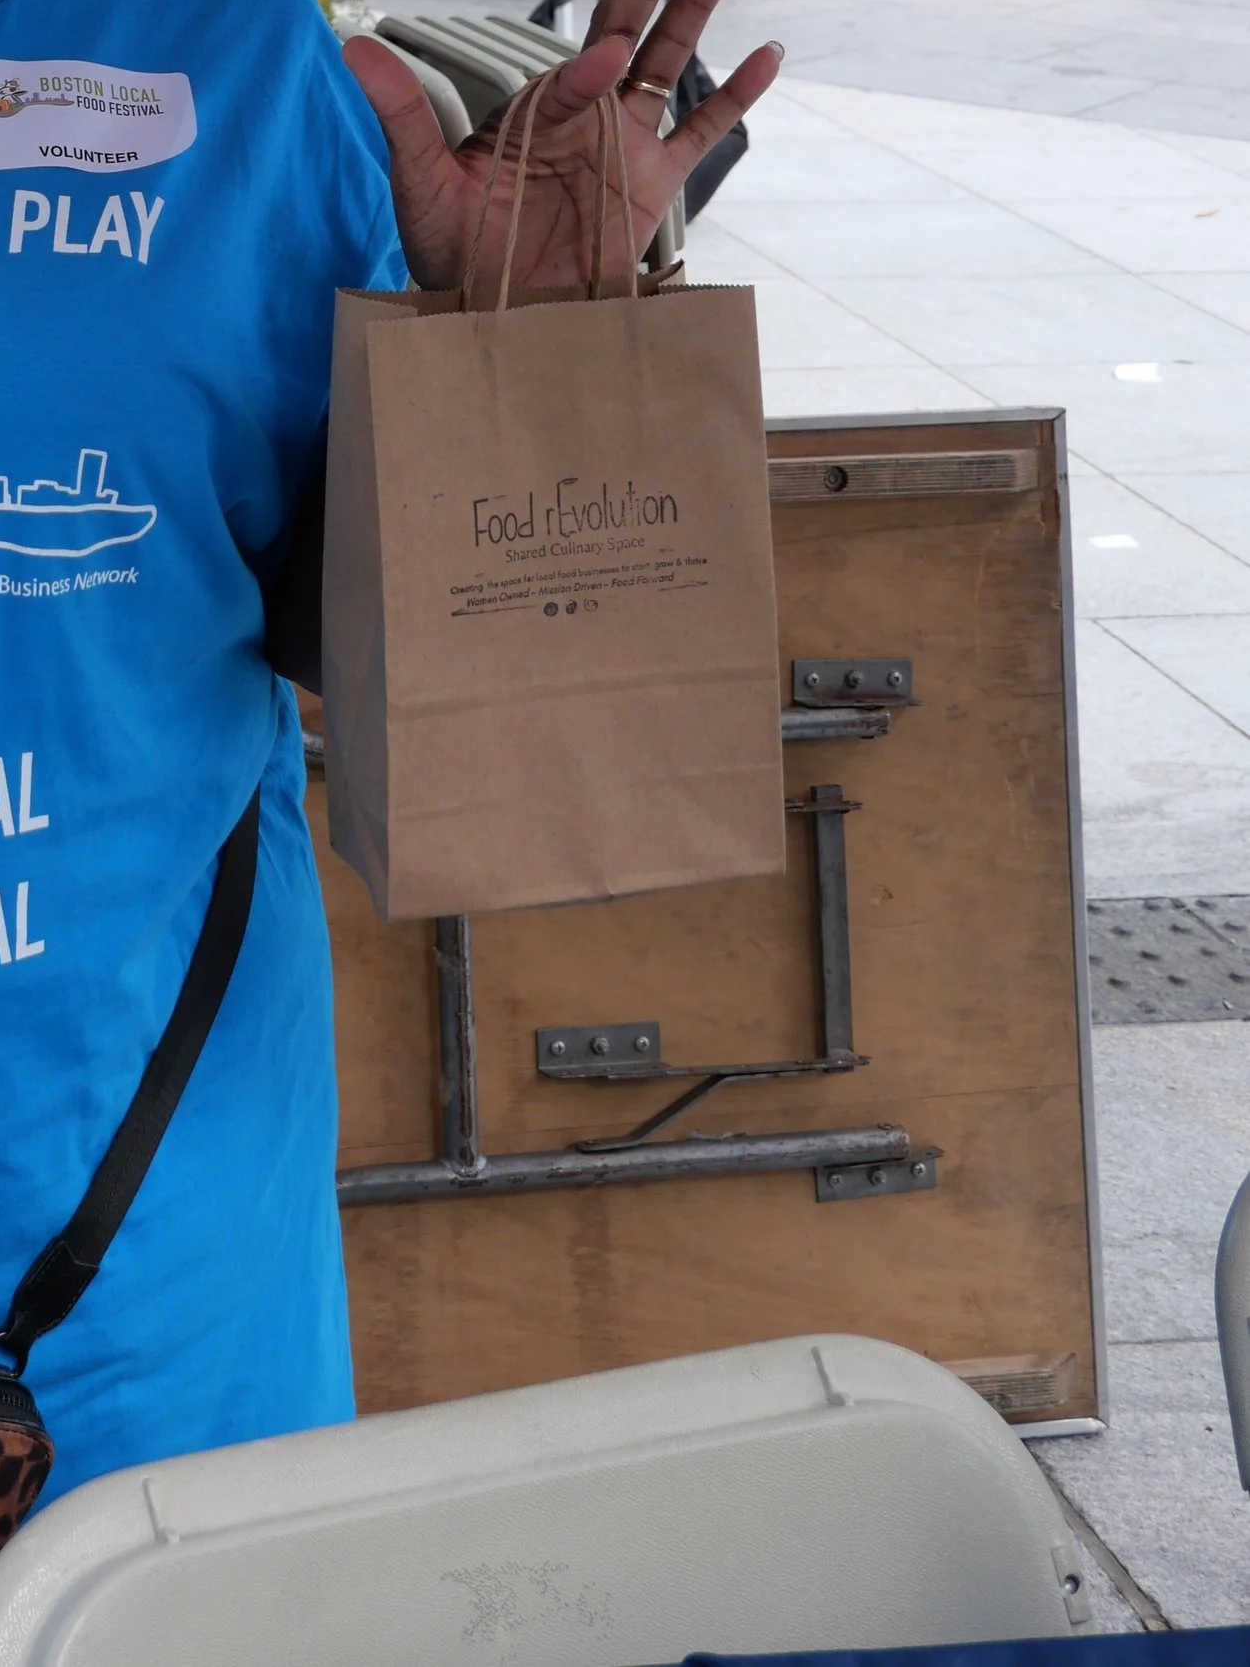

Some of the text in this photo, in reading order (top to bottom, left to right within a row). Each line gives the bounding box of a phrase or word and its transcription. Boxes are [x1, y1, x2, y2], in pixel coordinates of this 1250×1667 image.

[39, 76, 162, 103] BOSTON LOCAL
[76, 95, 165, 118] FOOD FESTIVAL
[38, 144, 139, 165] VOLUNTEER
[8, 189, 165, 265] PLAY
[472, 491, 535, 548] Food
[505, 536, 645, 563] Shared Culinary Space
[73, 566, 139, 591] Network
[499, 587, 531, 602] Owned
[611, 576, 635, 588] Food
